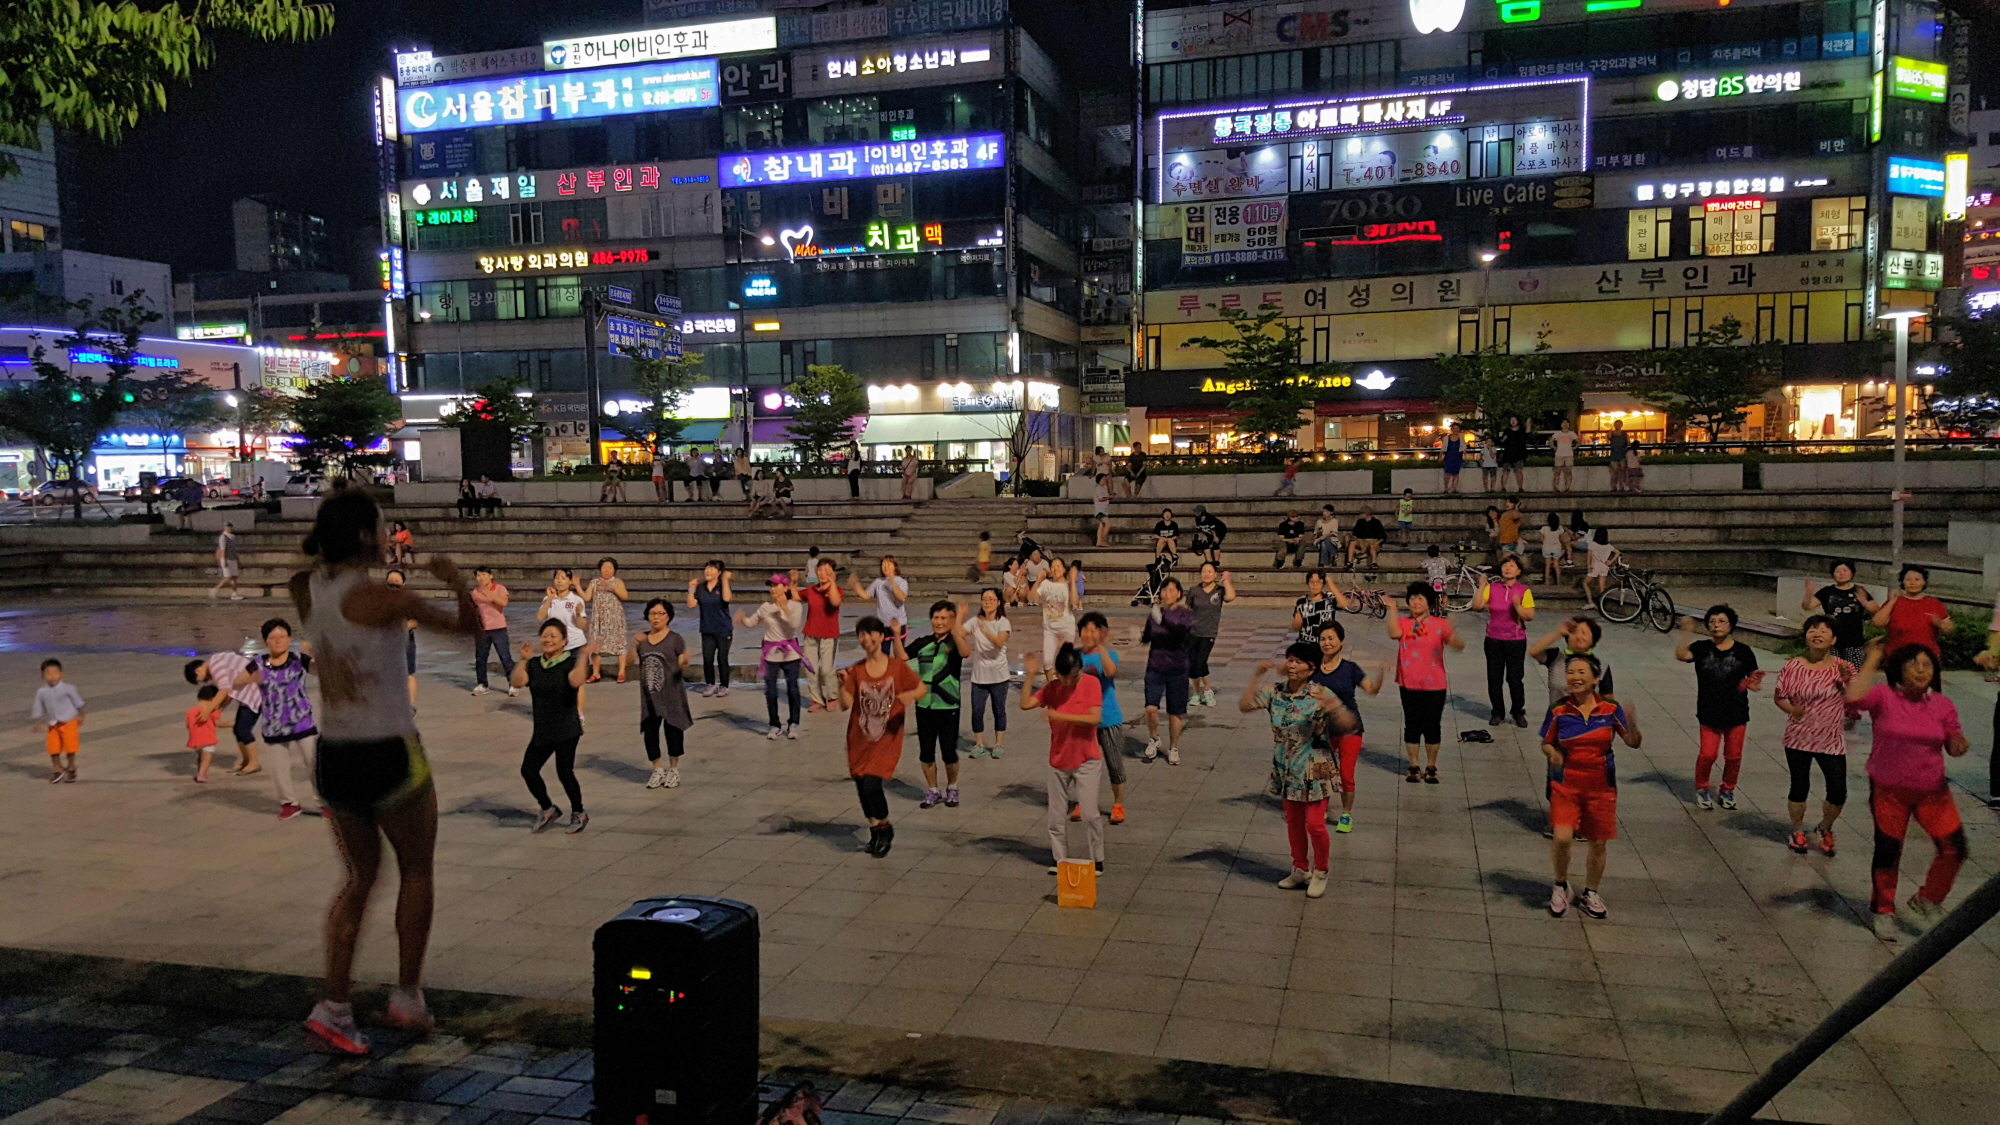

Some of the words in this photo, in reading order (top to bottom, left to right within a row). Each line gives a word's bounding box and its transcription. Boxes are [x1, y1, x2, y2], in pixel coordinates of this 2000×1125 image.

[1276, 9, 1349, 42] CMS
[584, 30, 709, 61] 하나이비인후과
[827, 58, 857, 79] 연세
[1519, 62, 1585, 77] 임플란트클리닉
[1589, 55, 1656, 71] 구강외과클리닉
[723, 60, 787, 96] 안과
[1410, 73, 1455, 87] 교정클리닉
[701, 87, 712, 100] 5F
[1429, 100, 1452, 117] 4F
[1516, 125, 1548, 139] 아로마
[976, 143, 999, 161] 4F
[1516, 142, 1540, 155] 커플
[1819, 138, 1846, 153] 비만
[764, 151, 858, 181] 참내과
[871, 139, 970, 164] 이비인후과
[1516, 159, 1548, 171] 스포츠
[440, 175, 536, 202] 서울제일
[557, 166, 661, 196] 산부인과
[1456, 186, 1494, 207] Live
[1503, 181, 1547, 204] Cafe
[1214, 206, 1240, 226] 전용
[1246, 203, 1279, 224] 110평
[1320, 189, 1423, 226] 7080
[1186, 205, 1205, 243] 임대
[1247, 225, 1279, 237] 60평
[868, 222, 920, 252] 치과
[925, 224, 943, 246] 맥
[1247, 236, 1278, 248] 50평
[1712, 231, 1754, 242] 야간진료
[528, 251, 589, 270] 외과의원
[592, 249, 649, 264] 486-9975
[794, 244, 818, 257] MAC
[1889, 257, 1940, 278] 산부인과
[1596, 262, 1757, 295] 산부인과
[1799, 274, 1844, 286] 성형외과
[1303, 278, 1462, 311] 여성의원
[263, 355, 301, 376] 핸드폰
